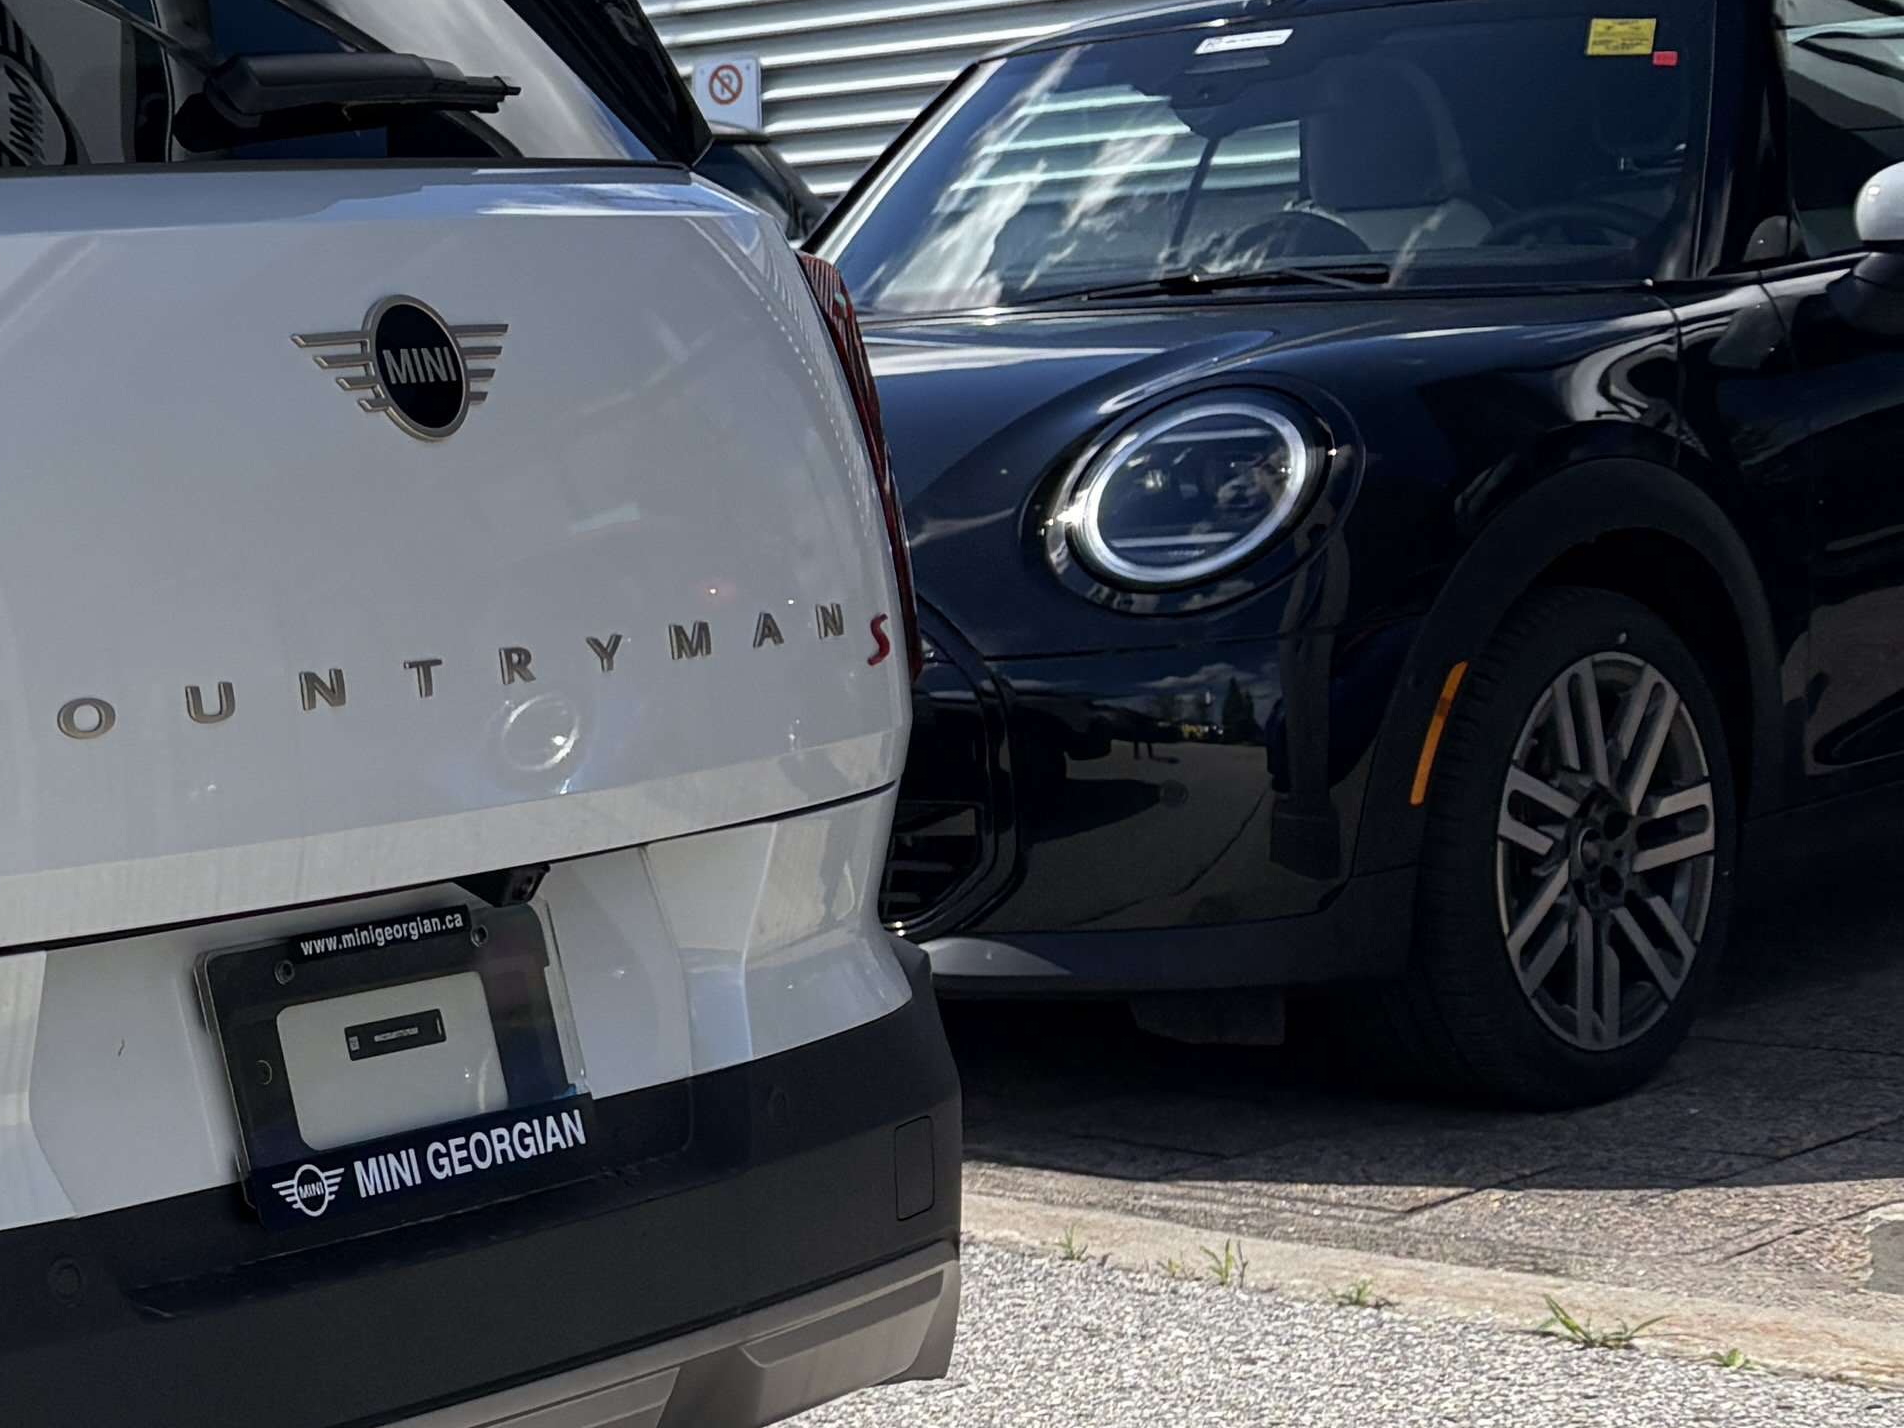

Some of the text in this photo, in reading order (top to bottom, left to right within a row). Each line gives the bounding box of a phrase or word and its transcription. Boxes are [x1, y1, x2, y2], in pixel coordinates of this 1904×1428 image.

[382, 345, 457, 385] MINI
[868, 614, 890, 667] S
[300, 912, 464, 957] www.minigeorgian.ca
[299, 1109, 587, 1200] MINI MINI GEORGIAN
